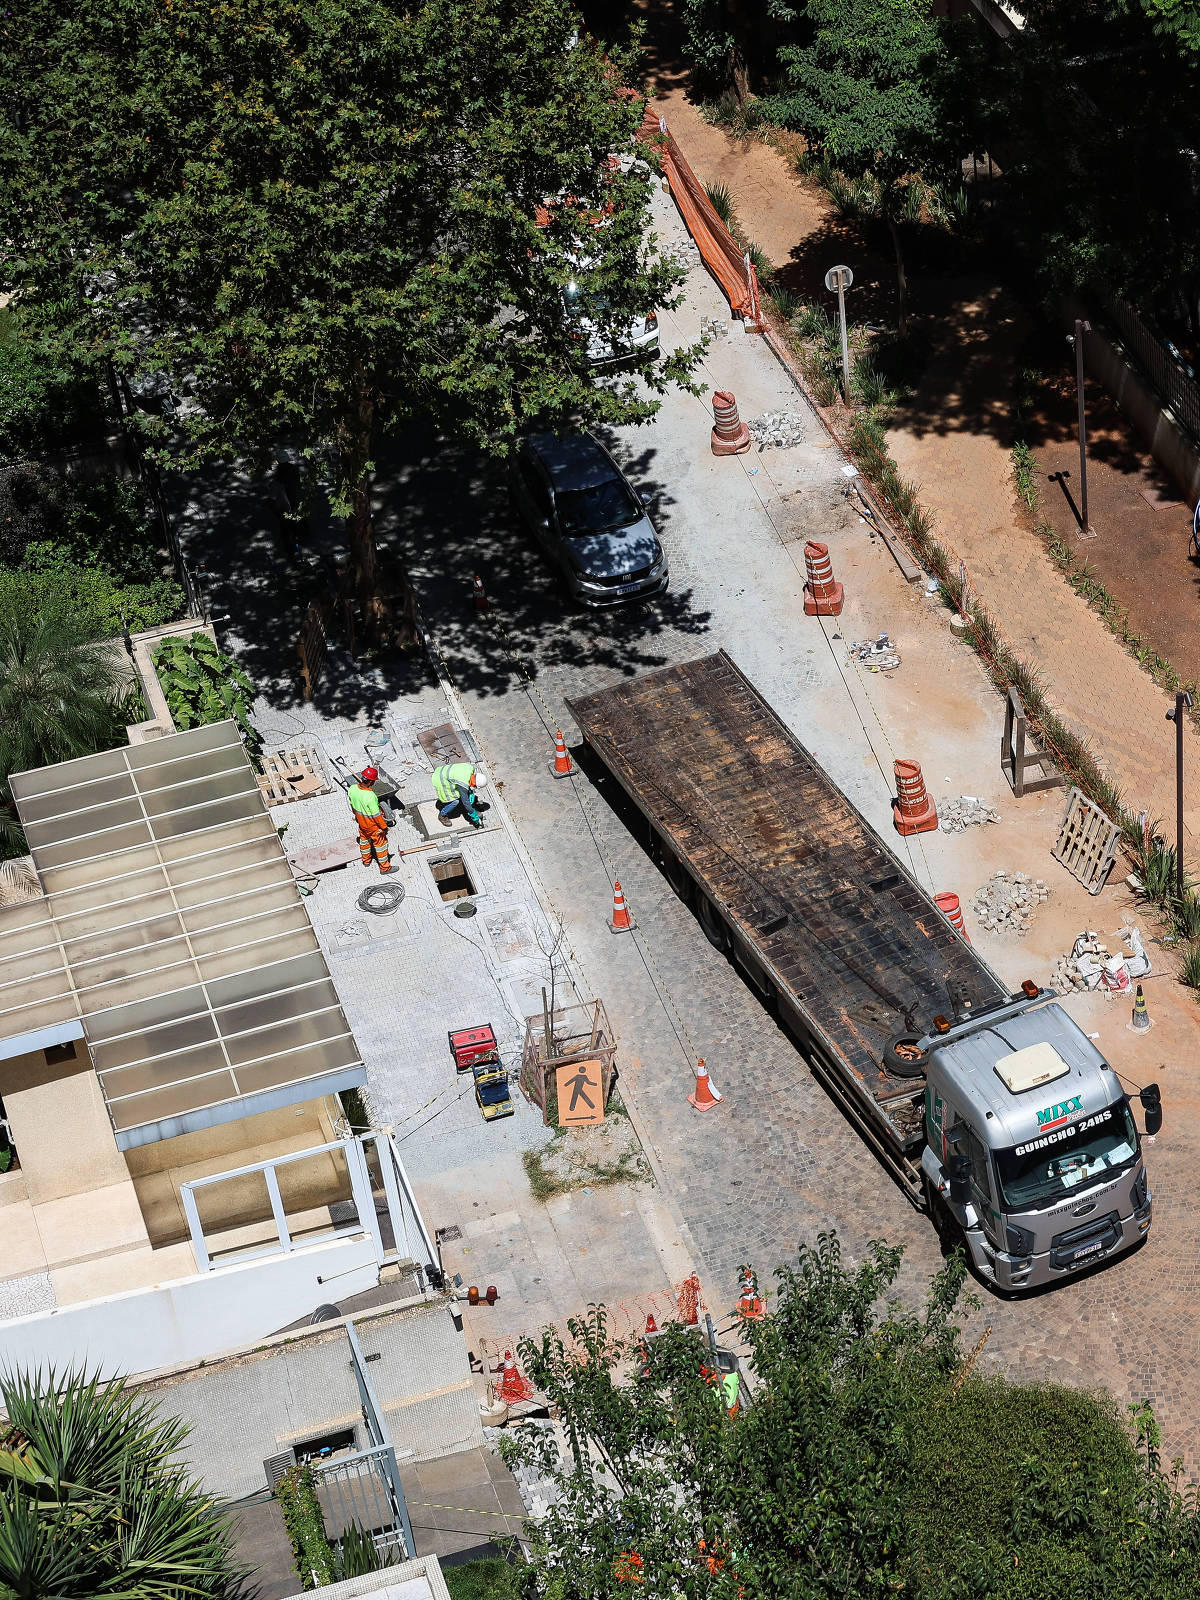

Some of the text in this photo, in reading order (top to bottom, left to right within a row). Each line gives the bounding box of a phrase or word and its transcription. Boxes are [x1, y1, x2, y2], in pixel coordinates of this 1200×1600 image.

[1036, 1095, 1083, 1126] MIXX
[1015, 1126, 1076, 1156] GUINCHO
[1078, 1110, 1112, 1132] 24HS
[1047, 1183, 1118, 1217] mixxguinchos.com.br
